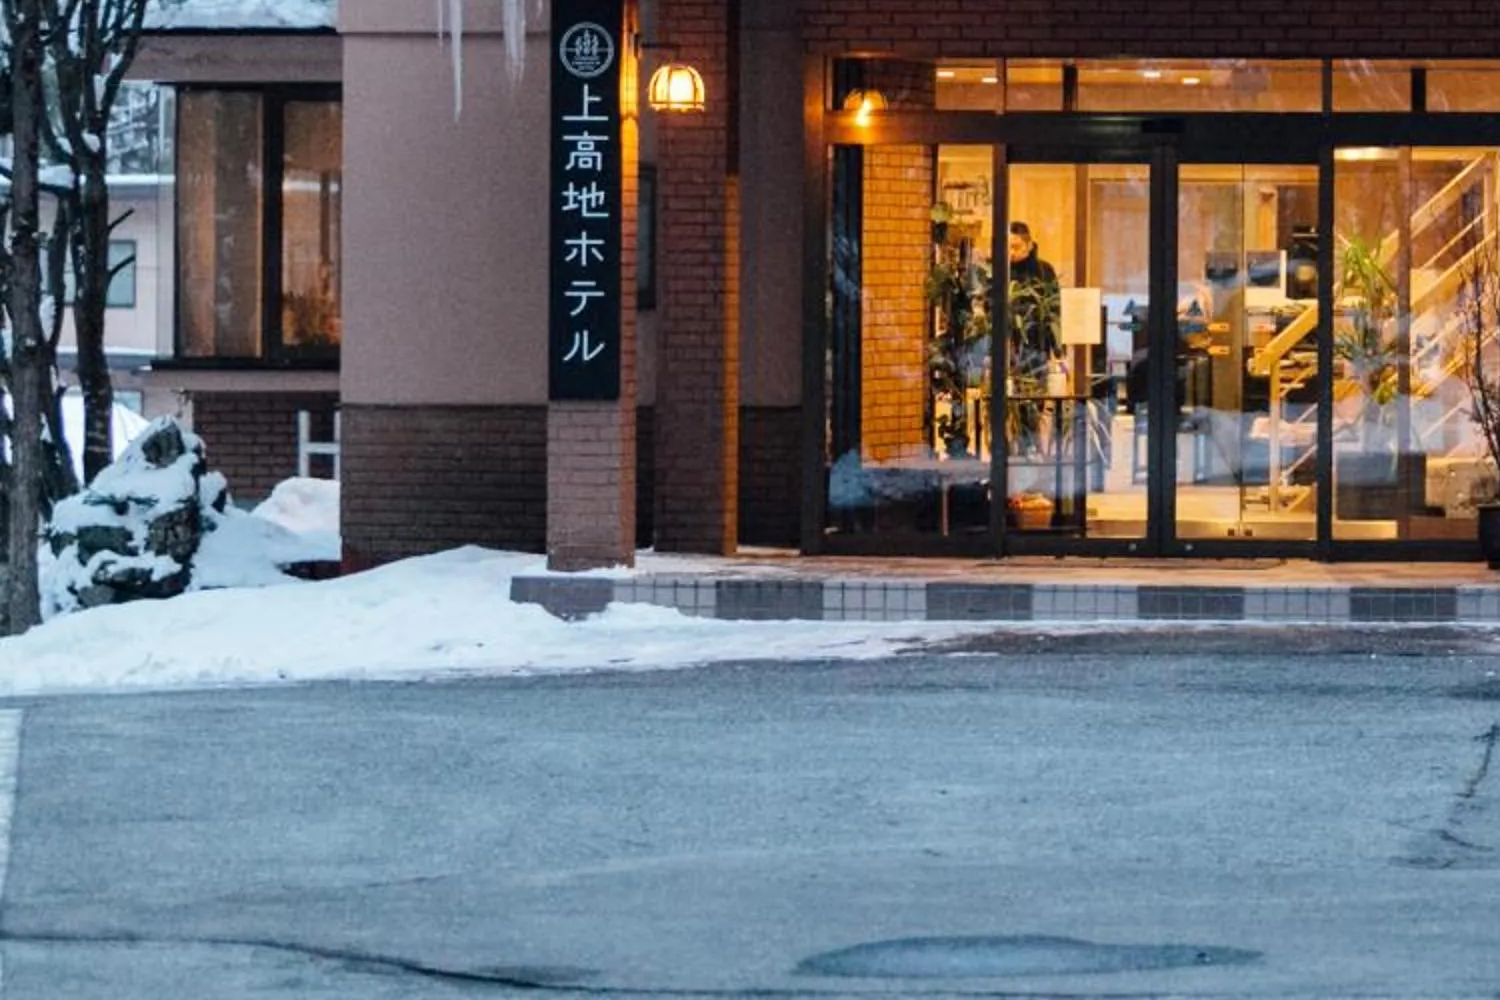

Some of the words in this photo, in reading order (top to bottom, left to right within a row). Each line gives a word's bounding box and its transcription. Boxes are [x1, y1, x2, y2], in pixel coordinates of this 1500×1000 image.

[561, 83, 610, 362] 上高地ホテル
